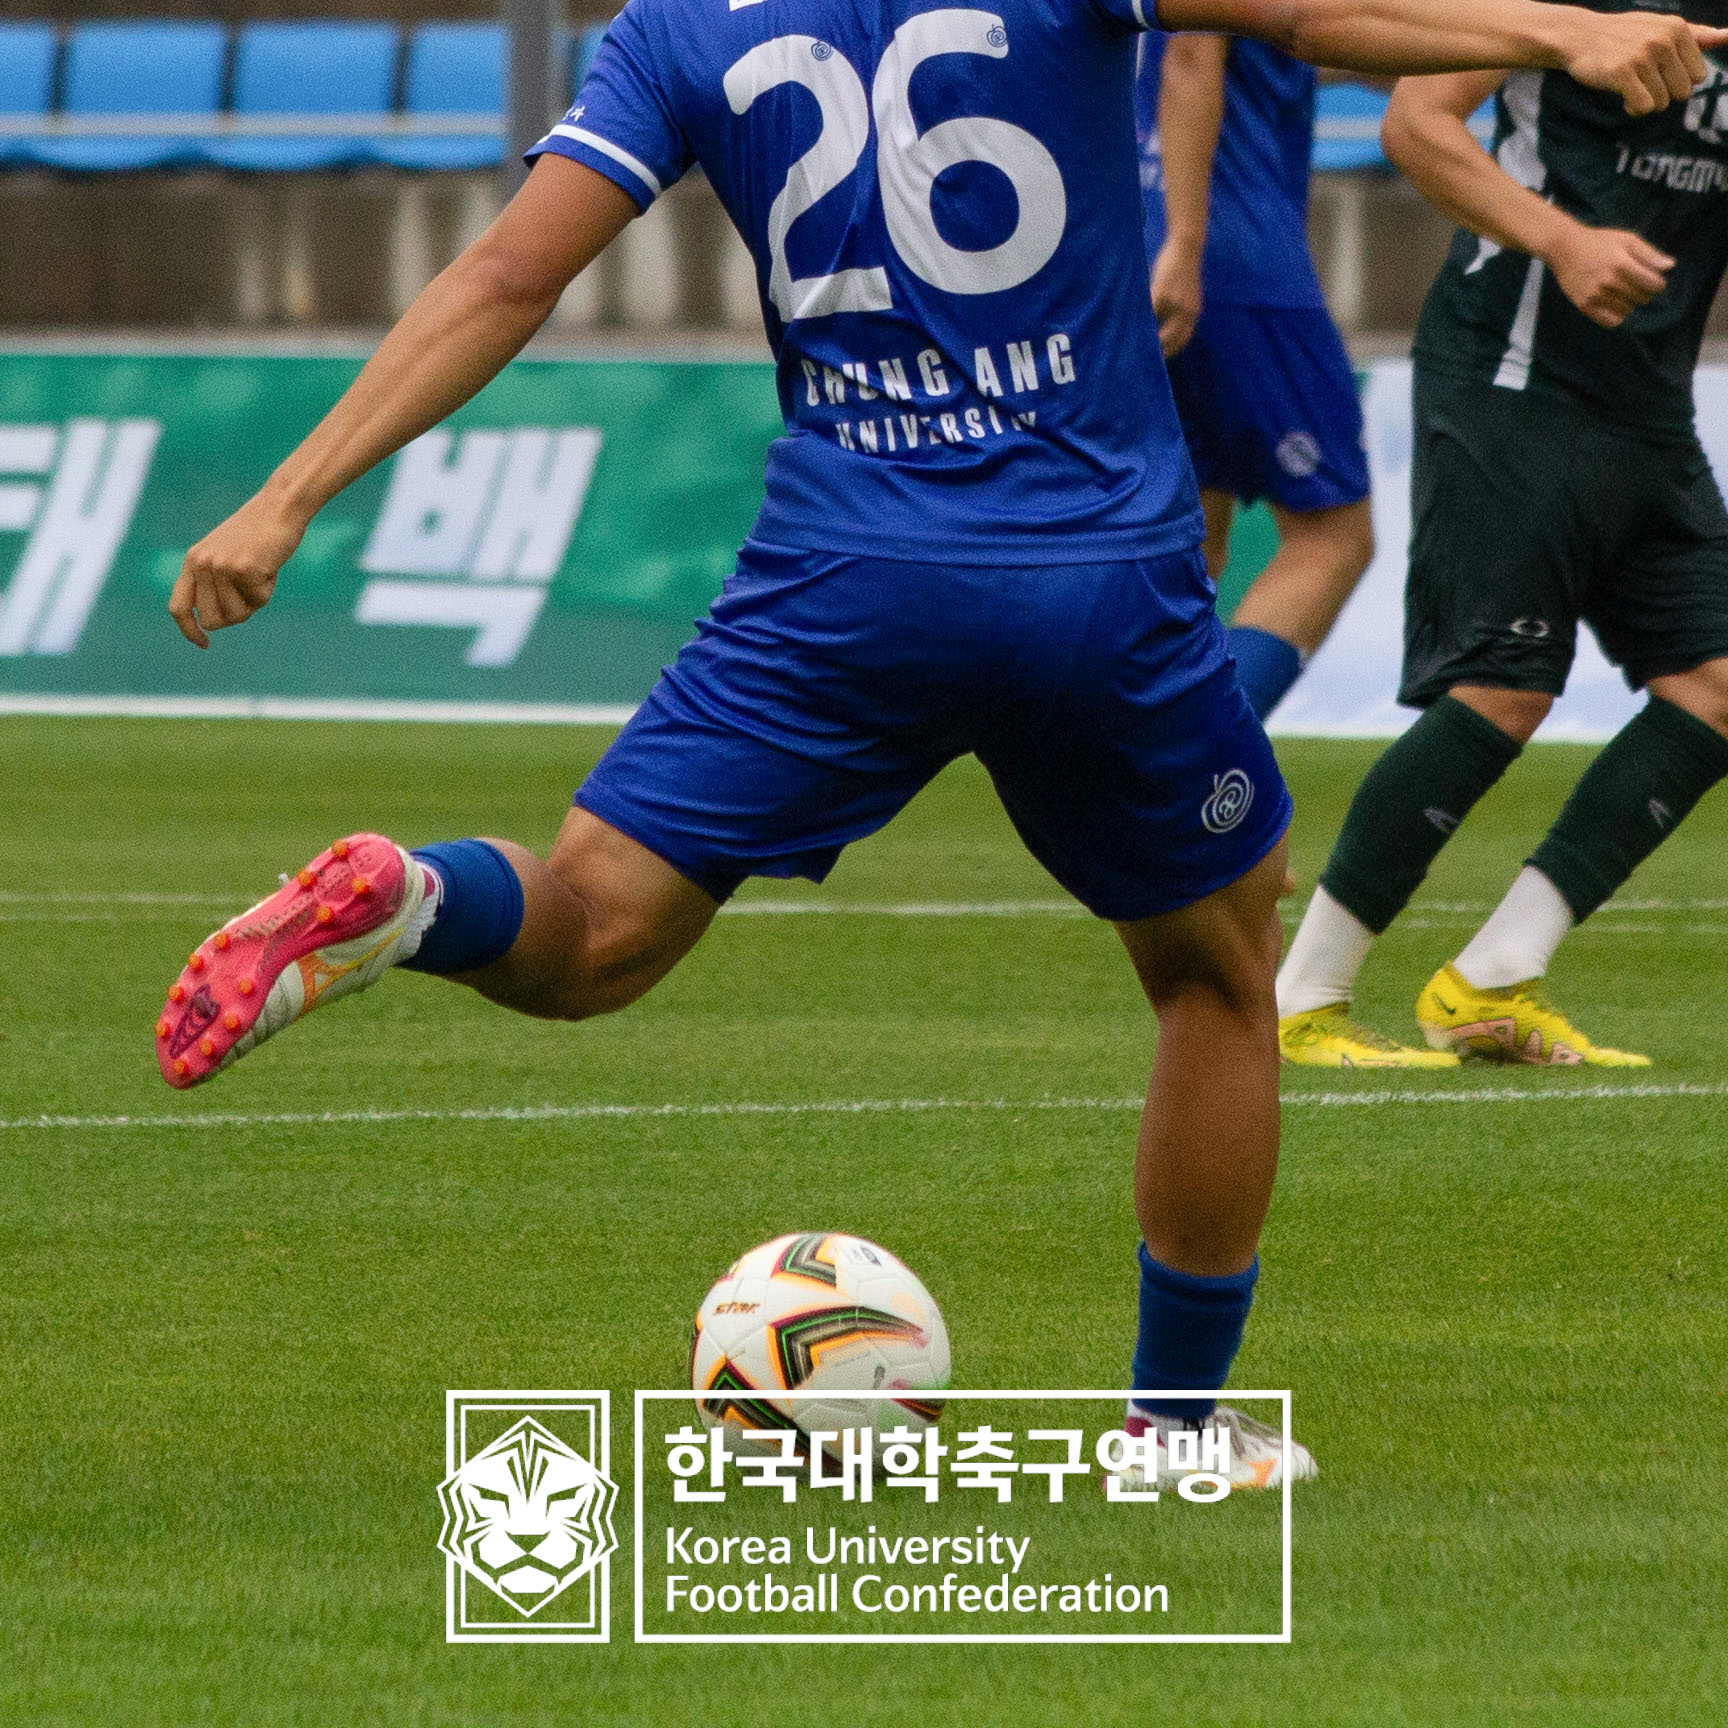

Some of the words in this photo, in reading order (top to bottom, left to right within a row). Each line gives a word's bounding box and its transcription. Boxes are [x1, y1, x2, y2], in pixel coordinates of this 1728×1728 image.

[723, 8, 1067, 323] 26
[800, 347, 950, 408] CHUNG
[973, 332, 1077, 399] ANG
